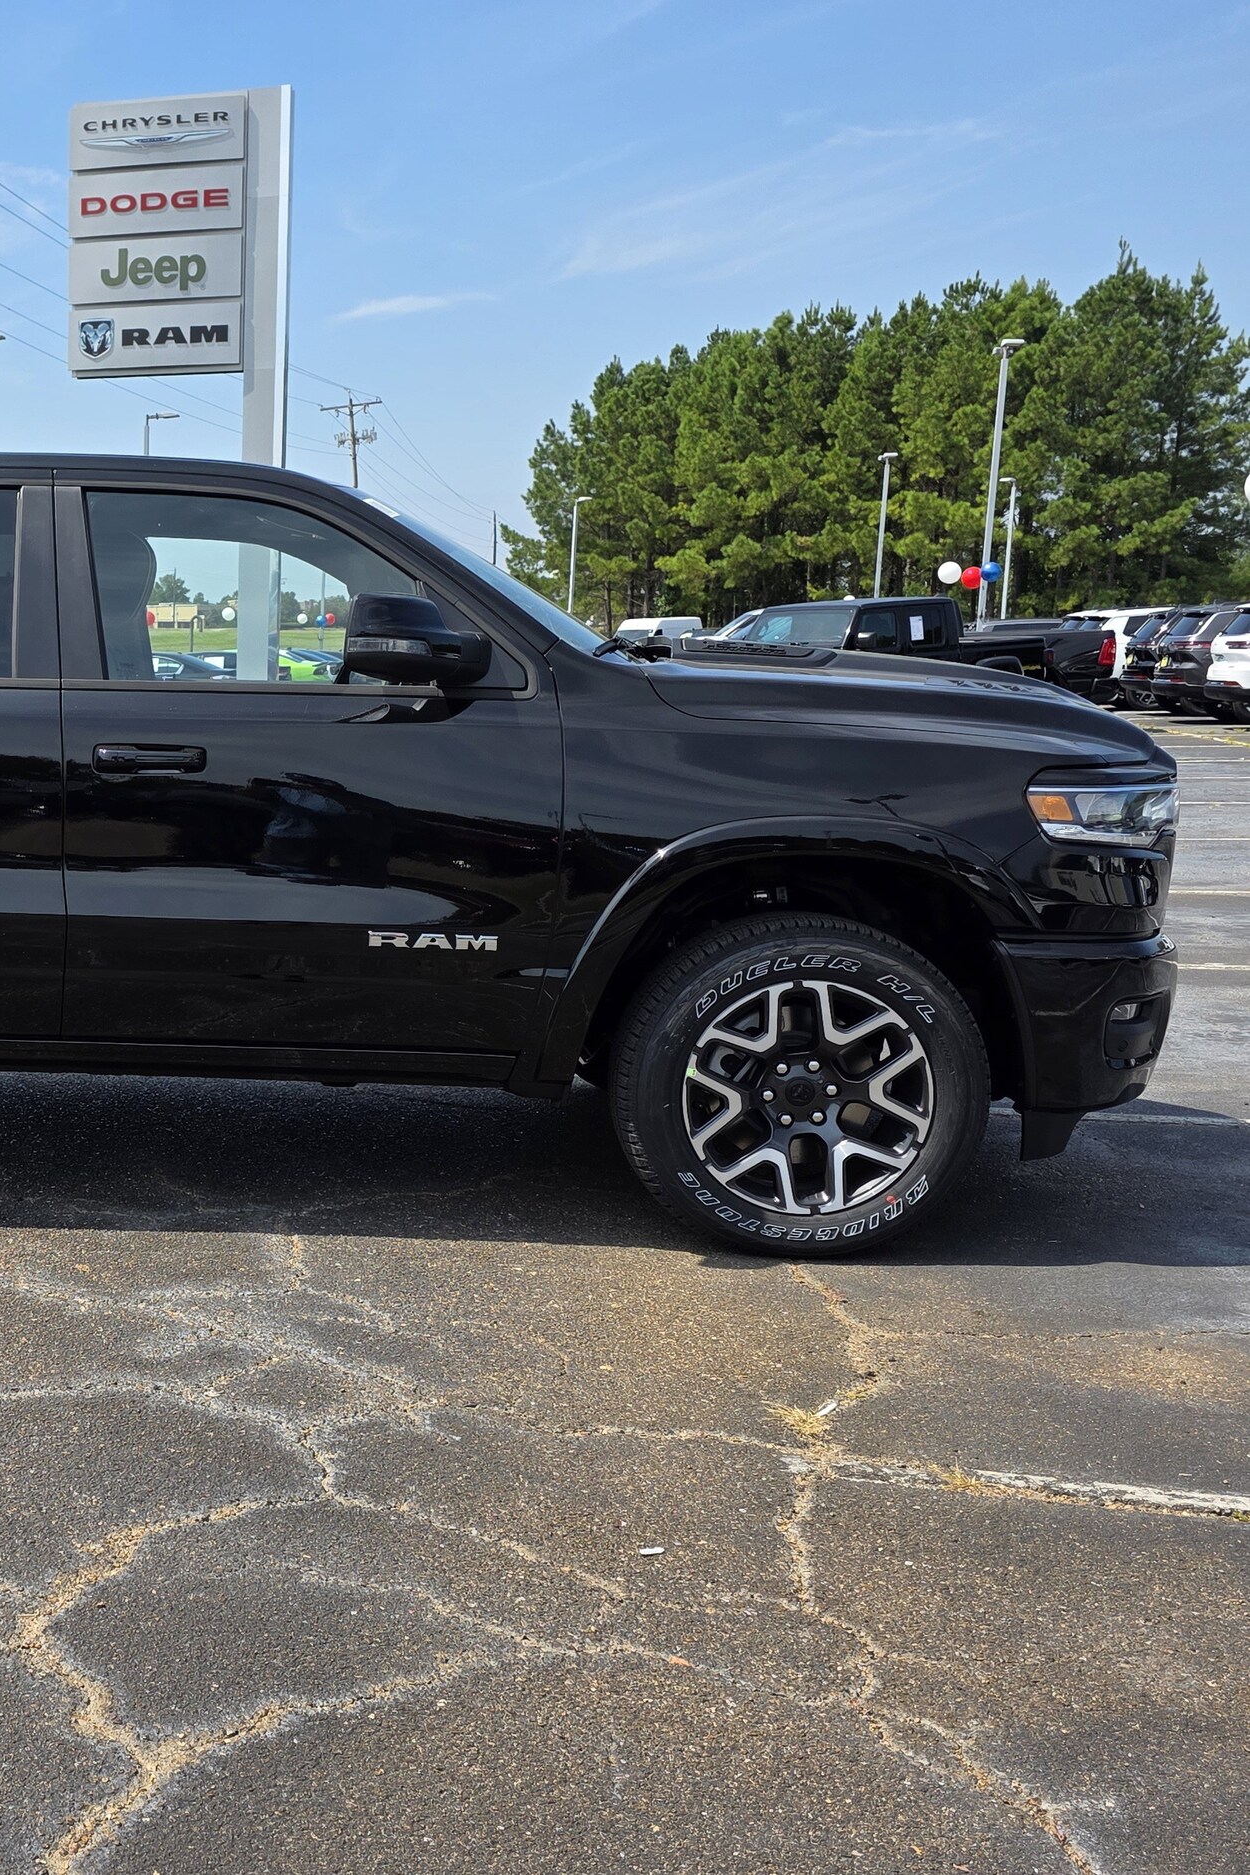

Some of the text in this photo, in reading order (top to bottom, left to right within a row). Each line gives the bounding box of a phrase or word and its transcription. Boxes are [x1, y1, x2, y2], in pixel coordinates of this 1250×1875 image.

[83, 111, 230, 132] CHRYSLER
[80, 188, 230, 216] DODGE
[100, 248, 207, 291] Jeep
[121, 325, 230, 347] RAM
[368, 930, 499, 952] RAM
[695, 954, 862, 1019] DUELER
[677, 1173, 931, 1241] BRIDGESTONE
